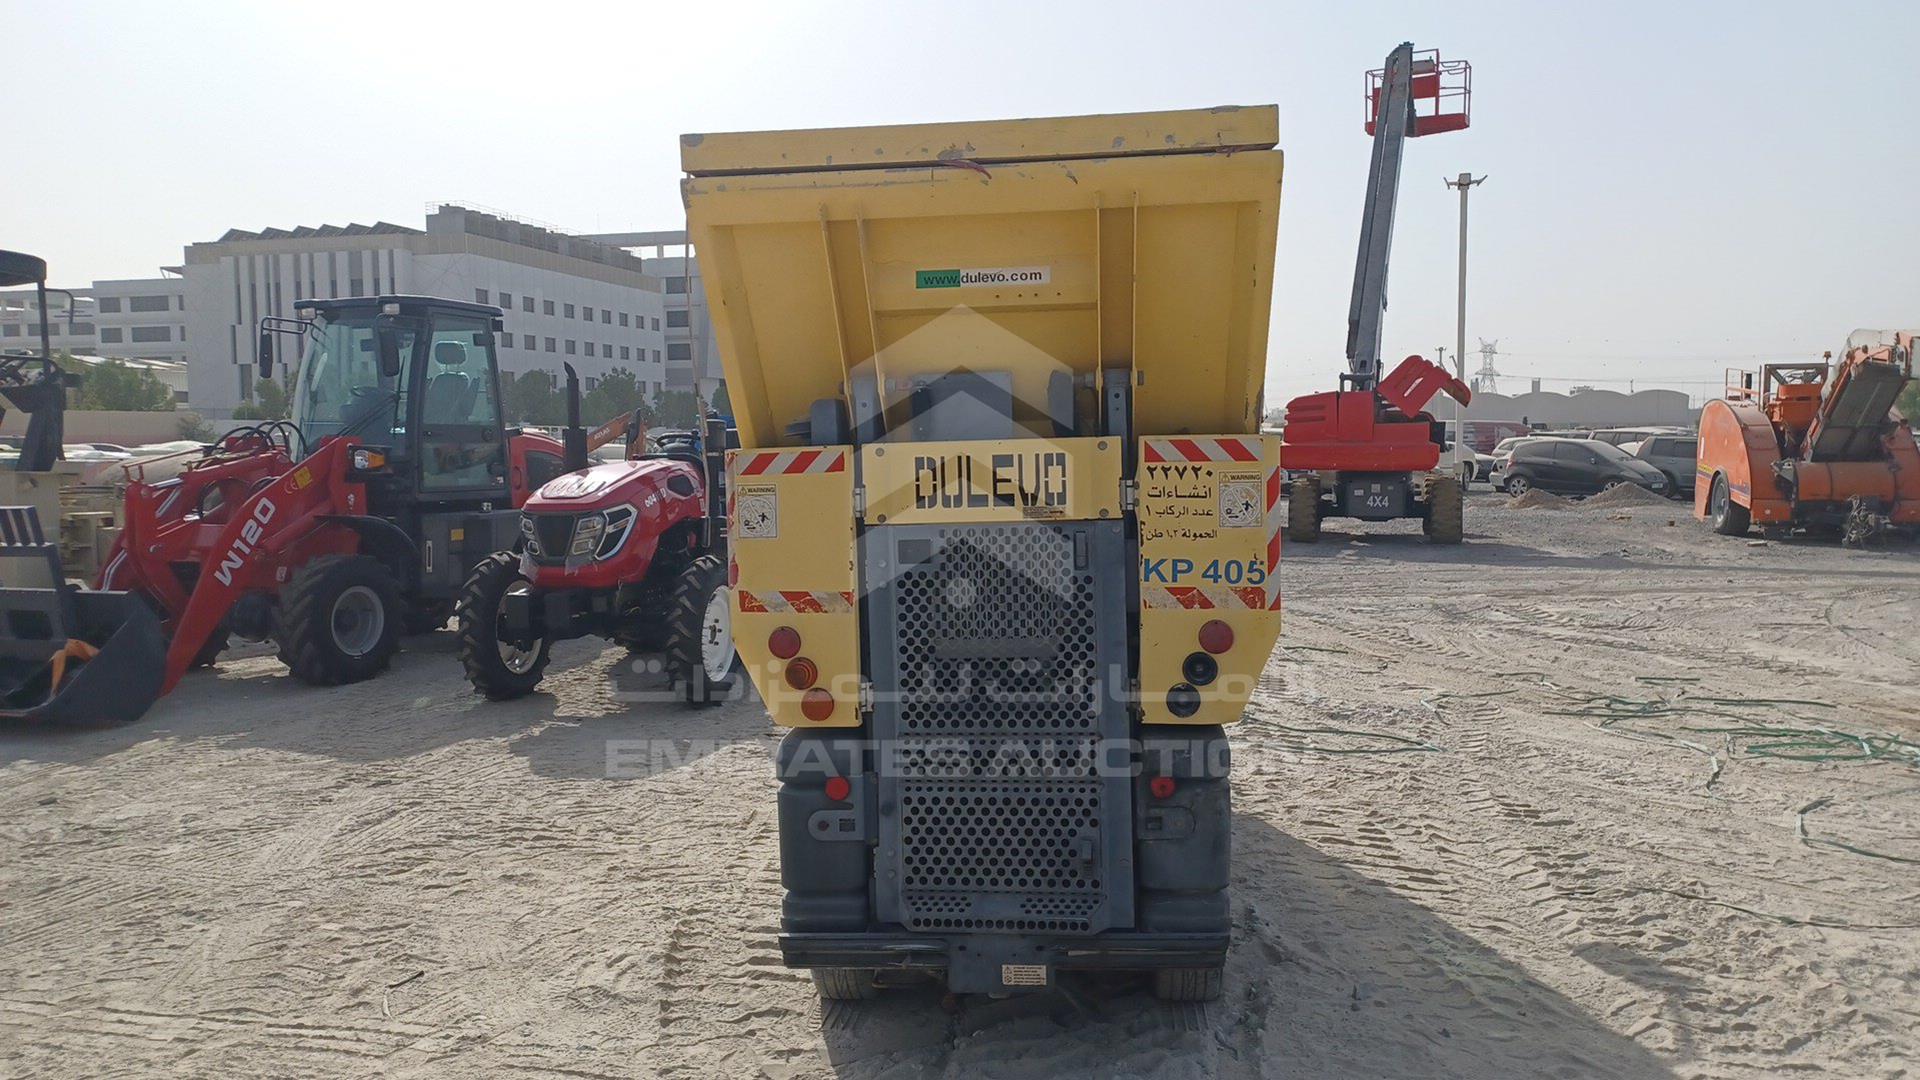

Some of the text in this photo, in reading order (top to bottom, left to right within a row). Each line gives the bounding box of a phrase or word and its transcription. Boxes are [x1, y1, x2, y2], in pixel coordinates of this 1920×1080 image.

[923, 270, 1042, 285] www.dulevo.com
[914, 452, 1067, 509] DULEVO
[1367, 495, 1389, 507] 4X4
[1155, 504, 1189, 518] الركاب
[1191, 508, 1214, 517] عدد
[1145, 528, 1164, 541] طن
[1181, 528, 1218, 541] الحمولة
[214, 497, 276, 587] W120
[1143, 558, 1266, 585] KP 405
